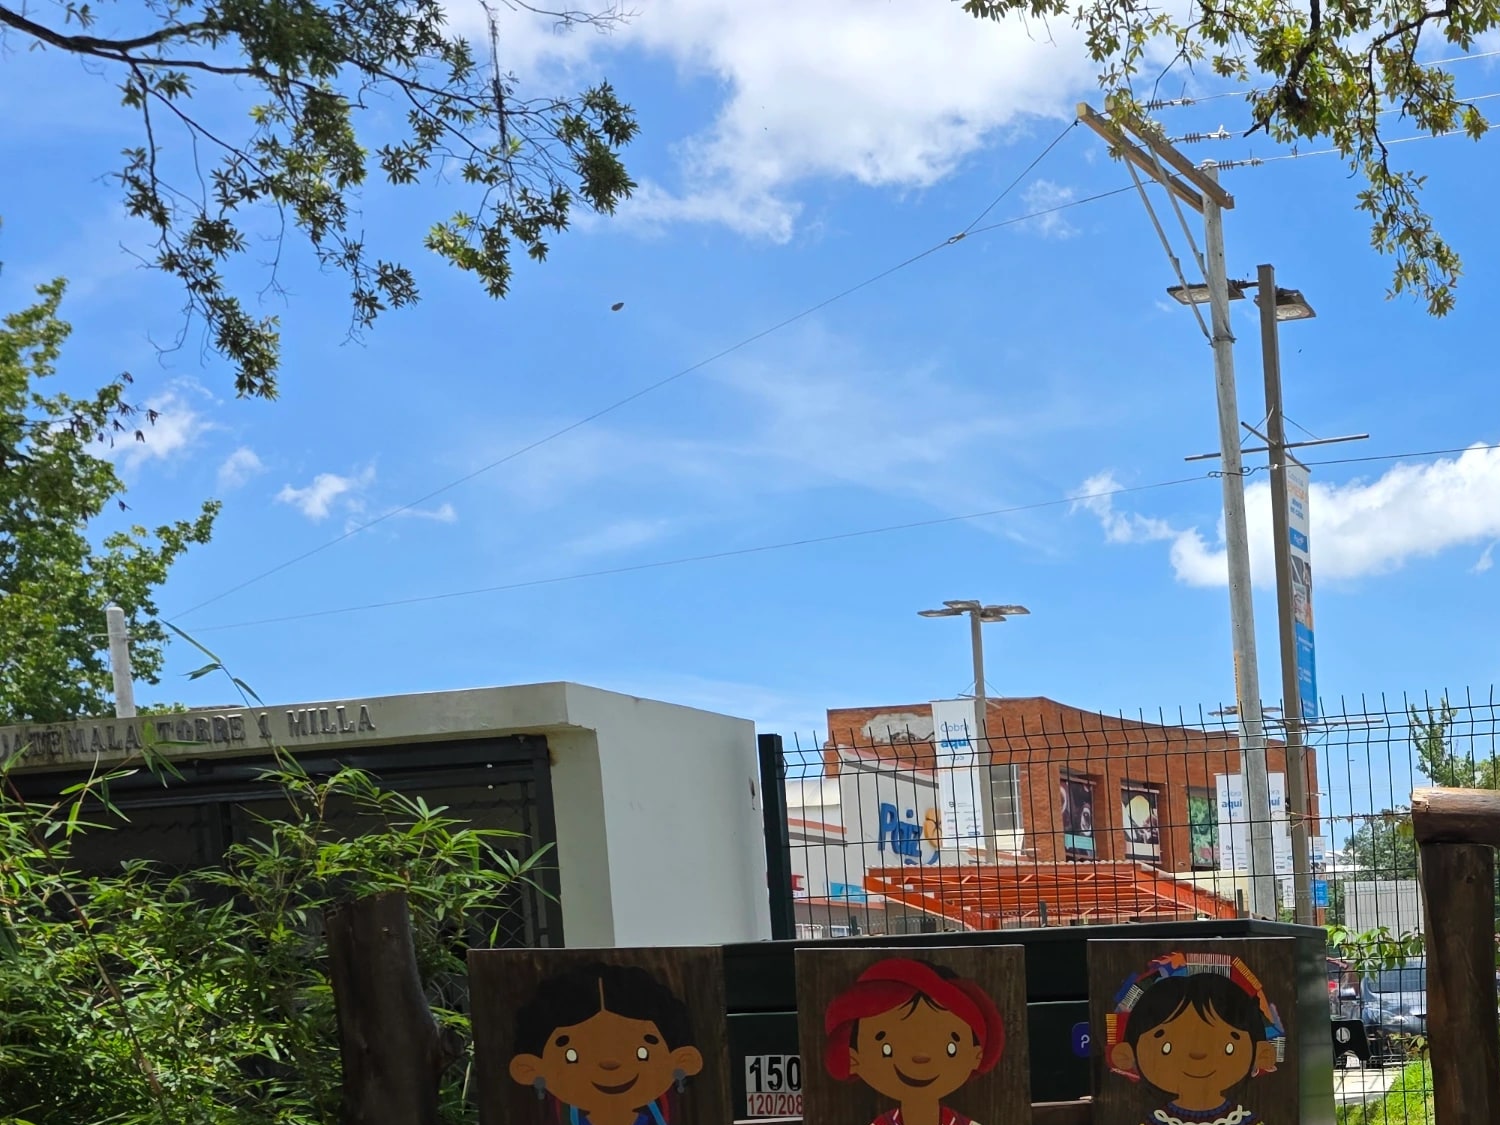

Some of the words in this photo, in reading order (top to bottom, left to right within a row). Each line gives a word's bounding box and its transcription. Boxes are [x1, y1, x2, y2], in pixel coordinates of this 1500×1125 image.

[157, 714, 246, 743] TORRE
[286, 704, 376, 738] MILLA
[878, 802, 924, 858] Paiz
[749, 1056, 802, 1092] 150
[748, 1094, 803, 1115] 120/208
